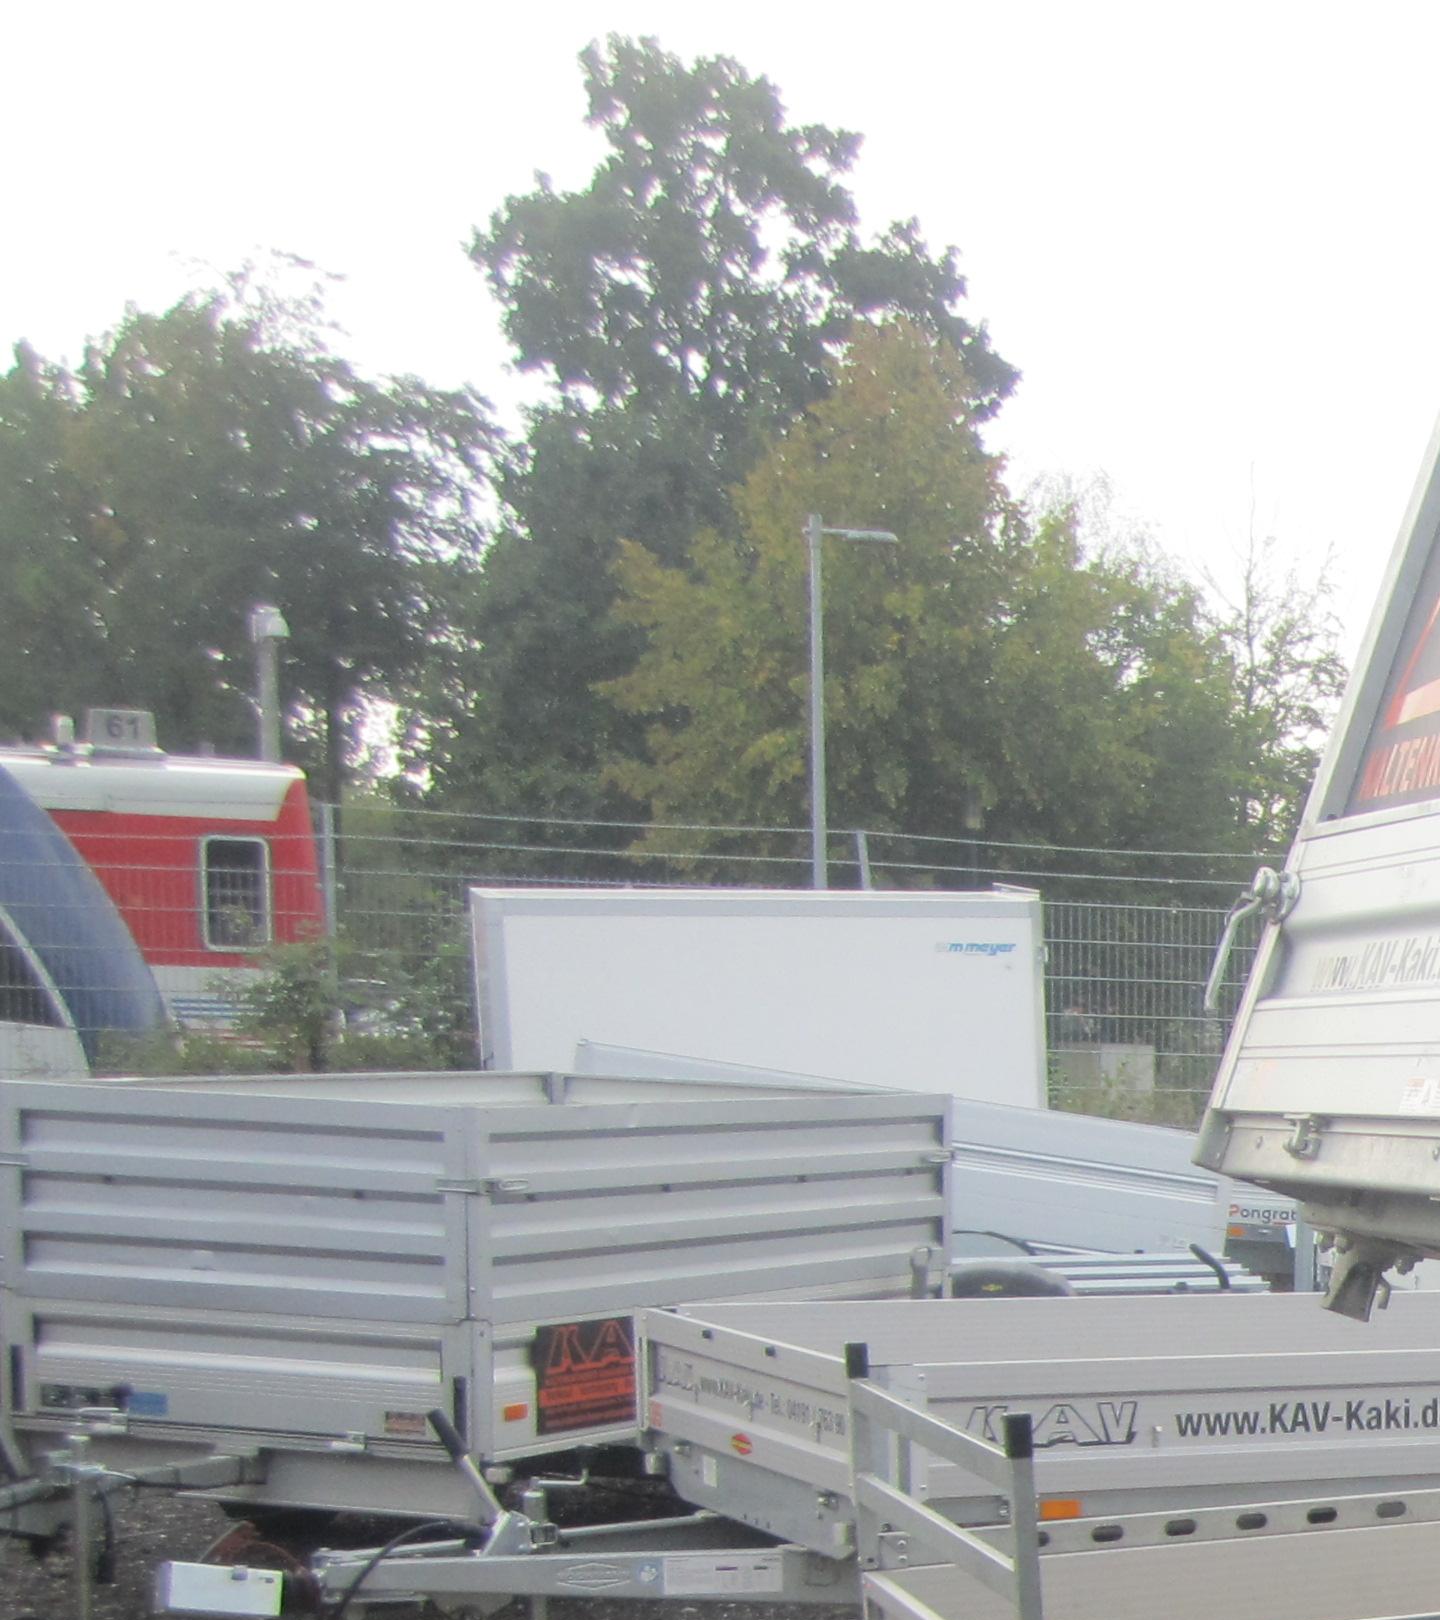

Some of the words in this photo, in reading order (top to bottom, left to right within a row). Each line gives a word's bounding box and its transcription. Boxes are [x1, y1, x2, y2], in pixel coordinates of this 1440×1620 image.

[106, 714, 139, 739] 61
[1228, 1204, 1297, 1224] Pongrat
[546, 1320, 636, 1374] KA
